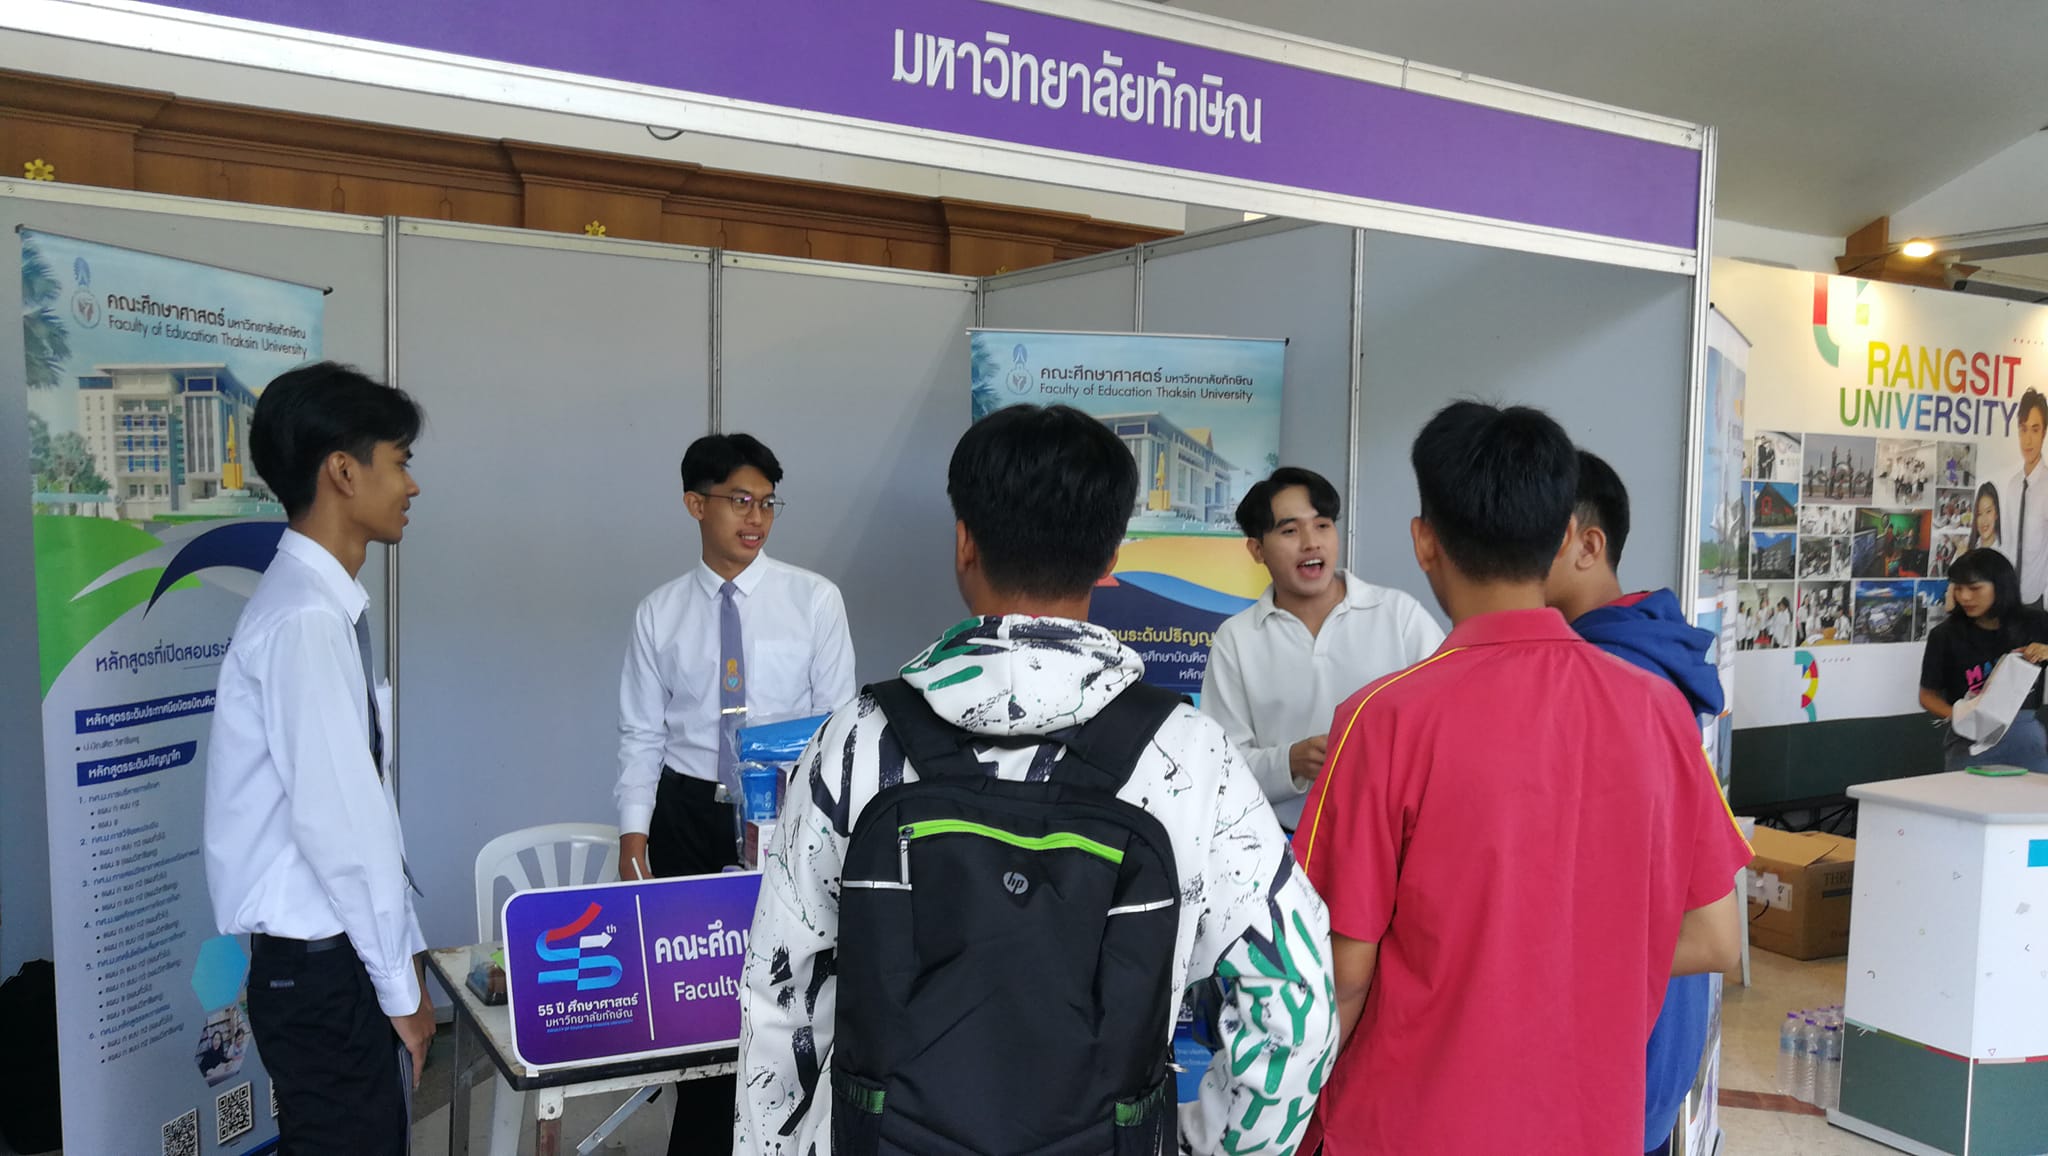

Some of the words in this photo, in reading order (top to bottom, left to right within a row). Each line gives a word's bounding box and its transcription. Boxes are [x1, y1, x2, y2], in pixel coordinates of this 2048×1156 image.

[892, 28, 1262, 144] มหาวิทยาลัยทักษิณ
[107, 293, 226, 326] คณะศึกษาศาสตร์
[108, 315, 149, 338] Faculty
[152, 321, 163, 336] of
[166, 323, 218, 345] Education
[221, 331, 260, 351] Thaksin
[261, 339, 308, 360] University
[1040, 365, 1163, 384] คณะศึกษาศาสตร์
[1165, 373, 1254, 387] มหาวิทยาลัยทักษิณ
[1867, 340, 2022, 398] RANGSIT
[1039, 383, 1079, 398] Faculty
[1083, 383, 1095, 396] of
[1097, 384, 1153, 398] Education
[1156, 386, 1197, 399] Thaksin
[1200, 388, 1254, 403] University
[1840, 387, 2019, 438] UNIVERSITY
[605, 924, 617, 934] th
[673, 975, 741, 1002] Faculty
[538, 1004, 554, 1016] 55
[556, 1001, 565, 1014] ปี
[567, 992, 639, 1013] ศึกษาศาสตร์
[545, 1009, 633, 1028] มหาวิทยาลัยทักษิณ
